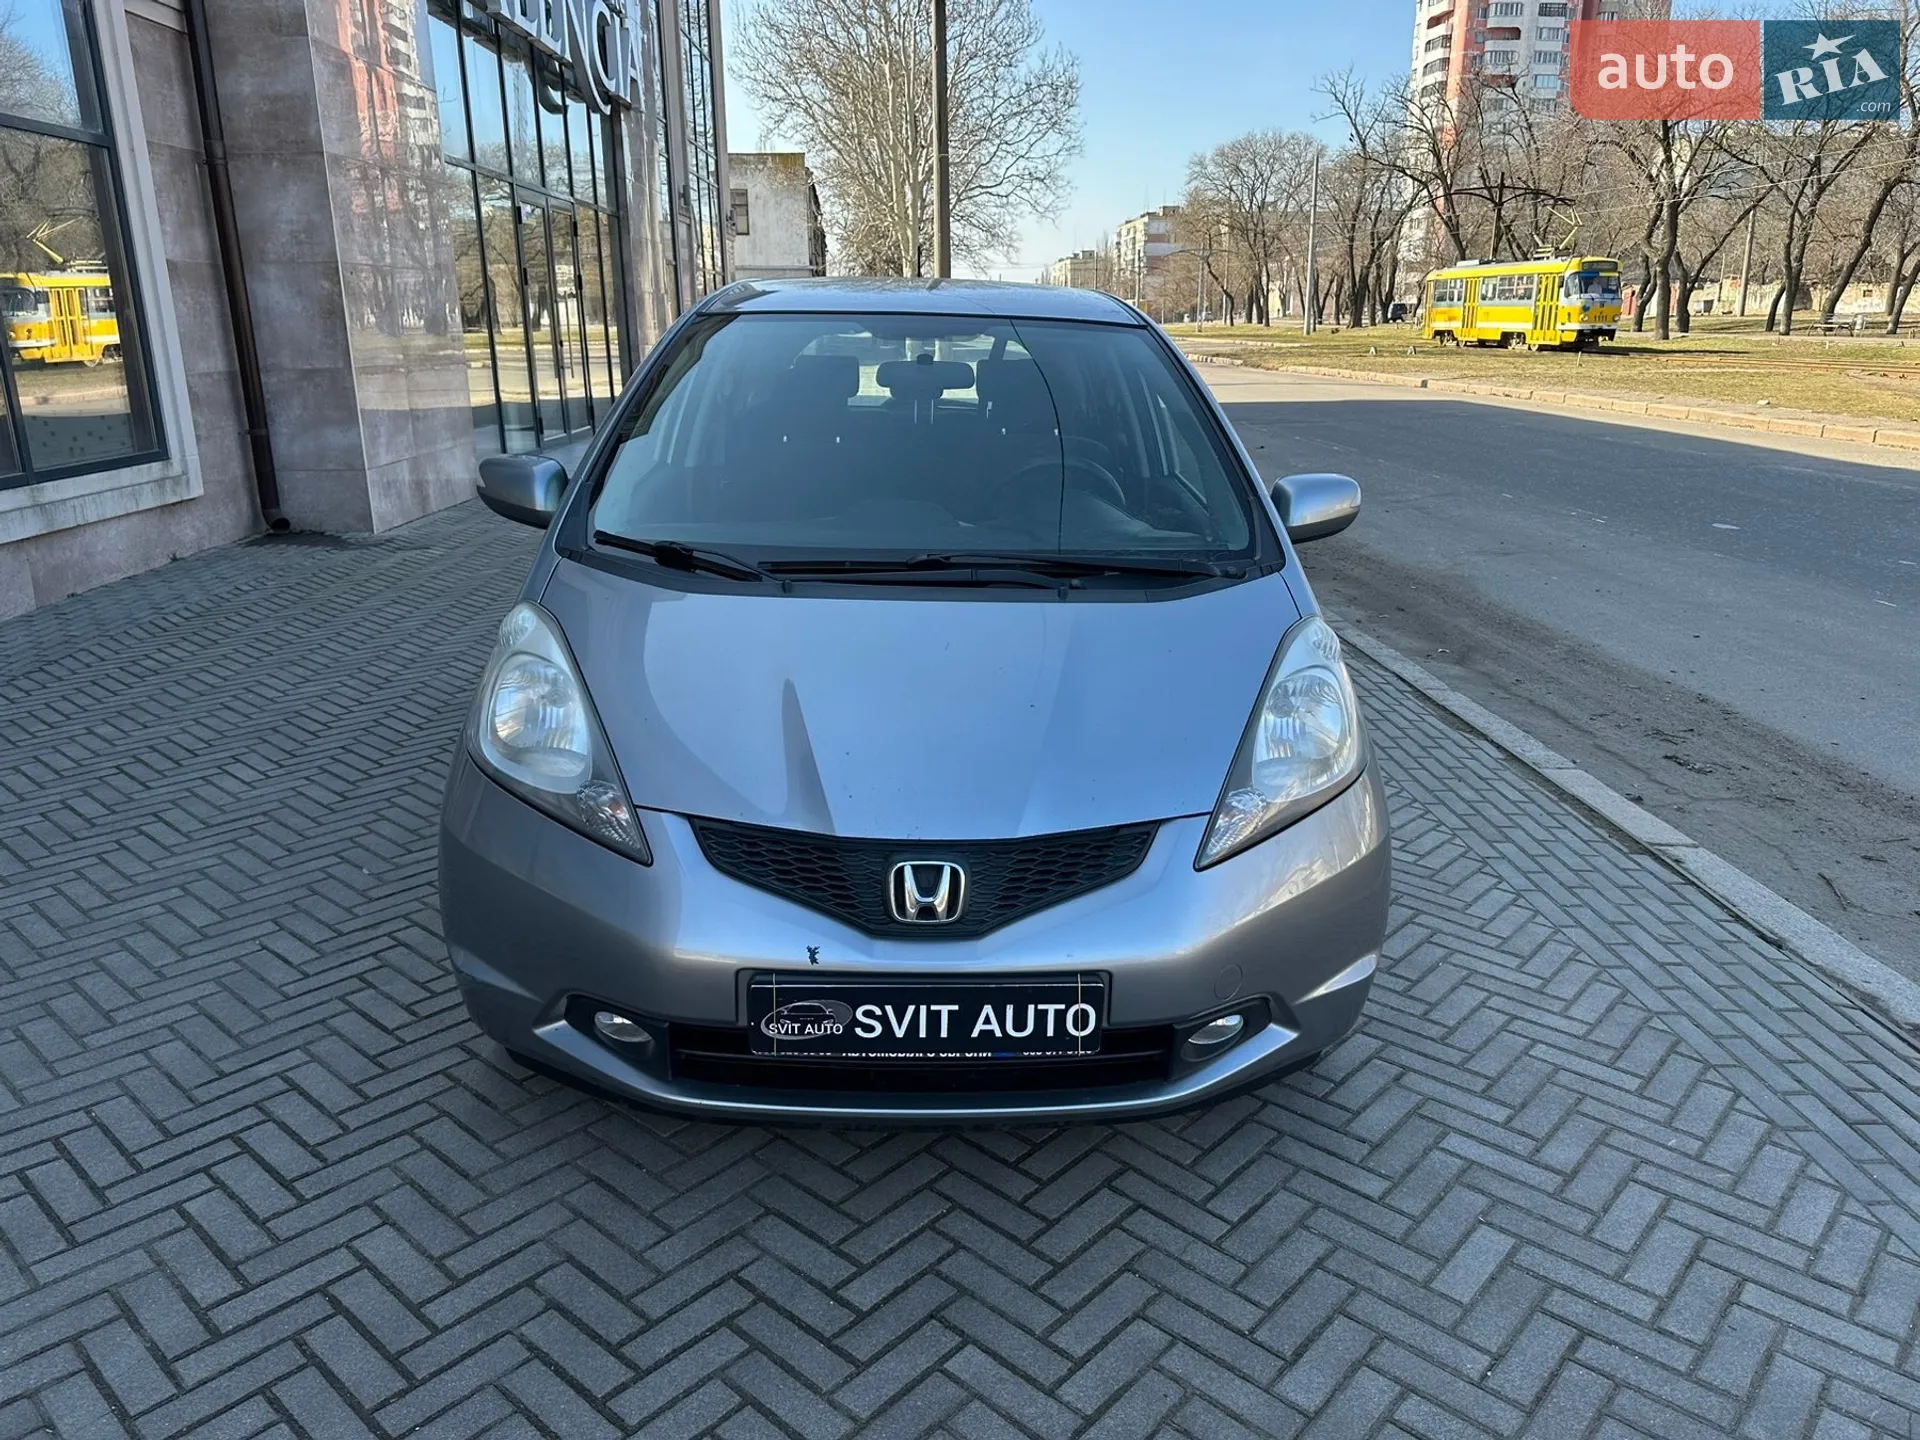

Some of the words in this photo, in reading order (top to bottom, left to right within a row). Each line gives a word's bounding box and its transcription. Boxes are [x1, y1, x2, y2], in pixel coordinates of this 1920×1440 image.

[768, 1023, 801, 1035] SVIT
[804, 1023, 843, 1035] AUTO
[854, 1004, 959, 1038] SVIT
[970, 1002, 1096, 1038] AUTO
